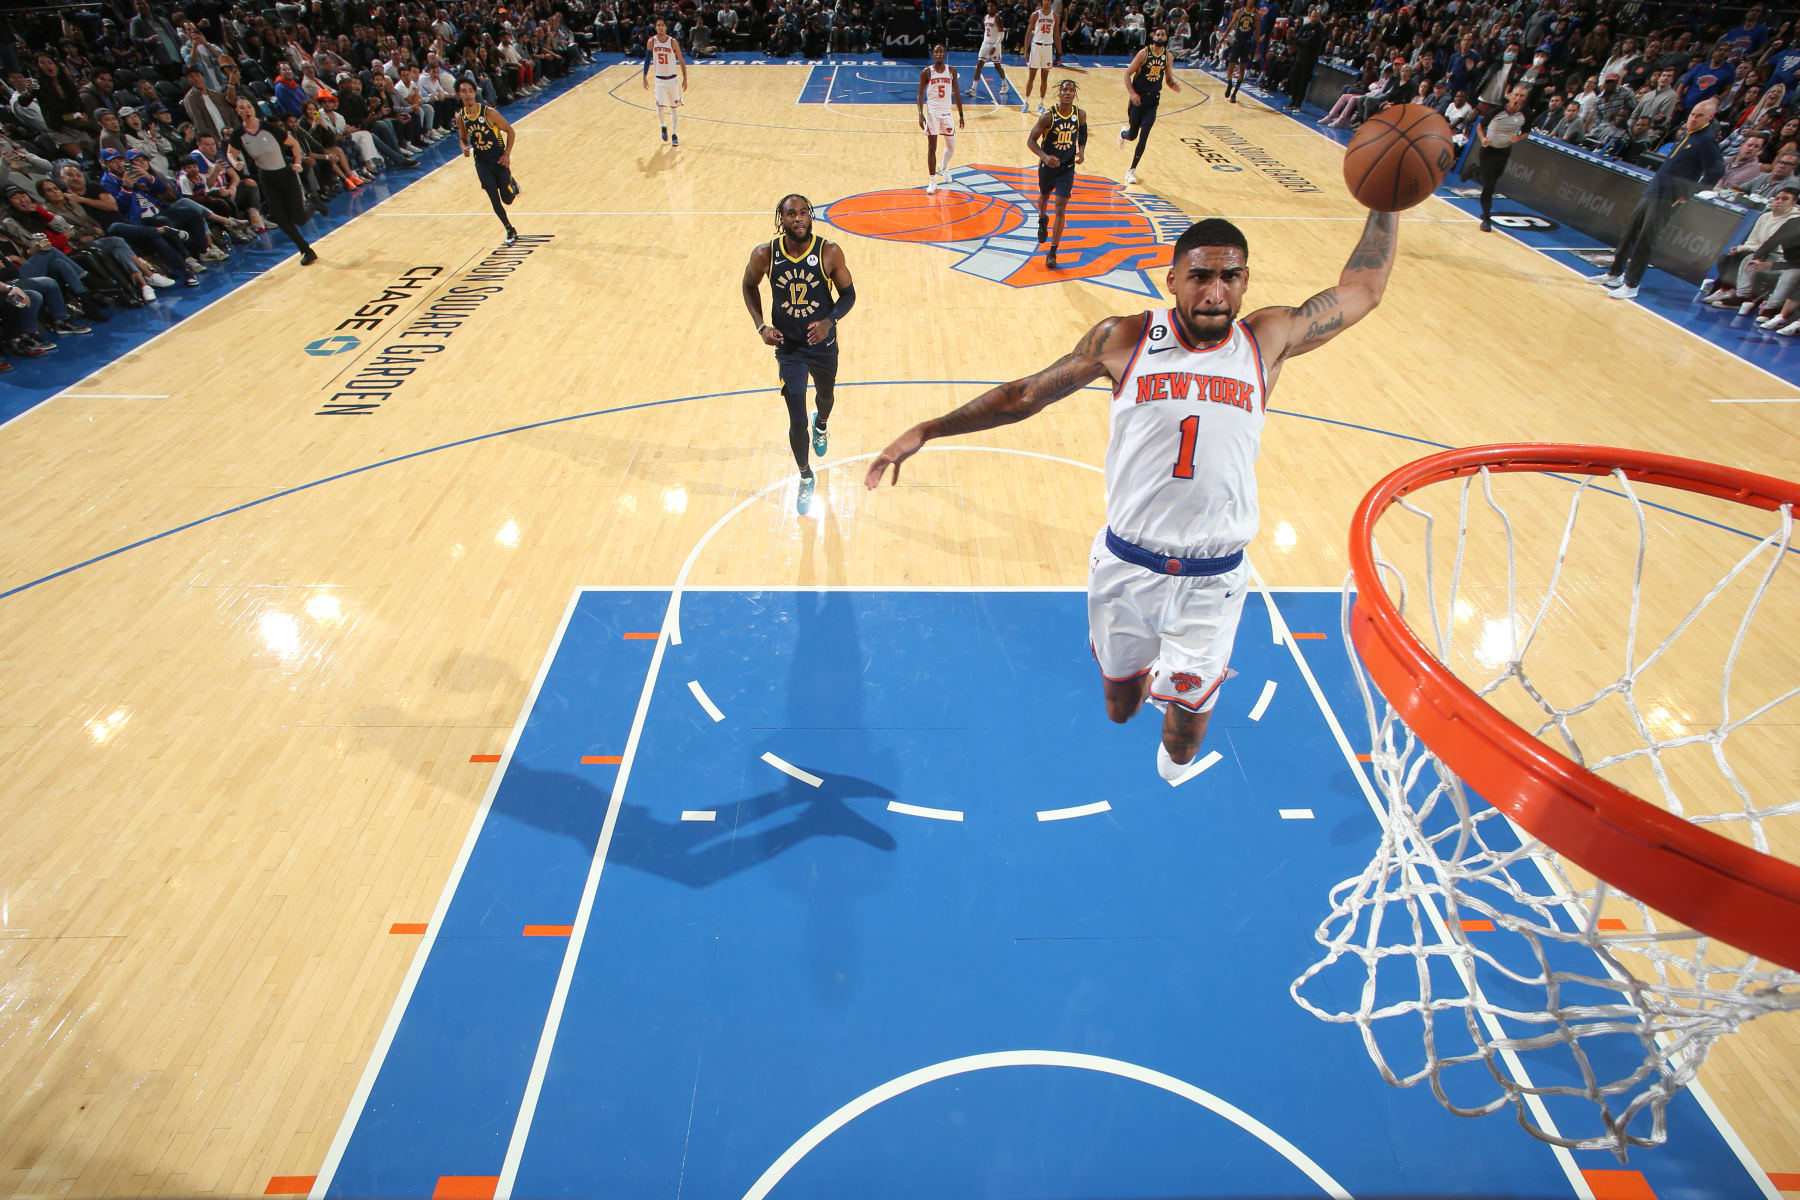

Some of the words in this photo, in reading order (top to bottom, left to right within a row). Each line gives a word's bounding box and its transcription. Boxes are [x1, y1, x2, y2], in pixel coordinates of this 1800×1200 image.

[1040, 24, 1052, 34] 45
[657, 53, 669, 65] 51
[938, 85, 945, 98] 5
[475, 131, 485, 145] 2
[1053, 122, 1077, 135] INDIANA
[1057, 130, 1072, 144] 00
[1180, 137, 1230, 163] CHASE
[1123, 192, 1184, 213] NEW
[1557, 183, 1617, 216] BETMGM
[1490, 215, 1552, 228] 6
[776, 268, 820, 288] INDIANA
[333, 266, 444, 331] CHASE
[789, 282, 809, 305] 12
[398, 286, 504, 338] SQUARE
[781, 300, 820, 318] PACERS
[1151, 326, 1163, 339] 6
[314, 344, 446, 416] GARDEN
[1135, 372, 1193, 404] NEW
[1193, 375, 1255, 412] YORK
[1172, 414, 1200, 479] 1
